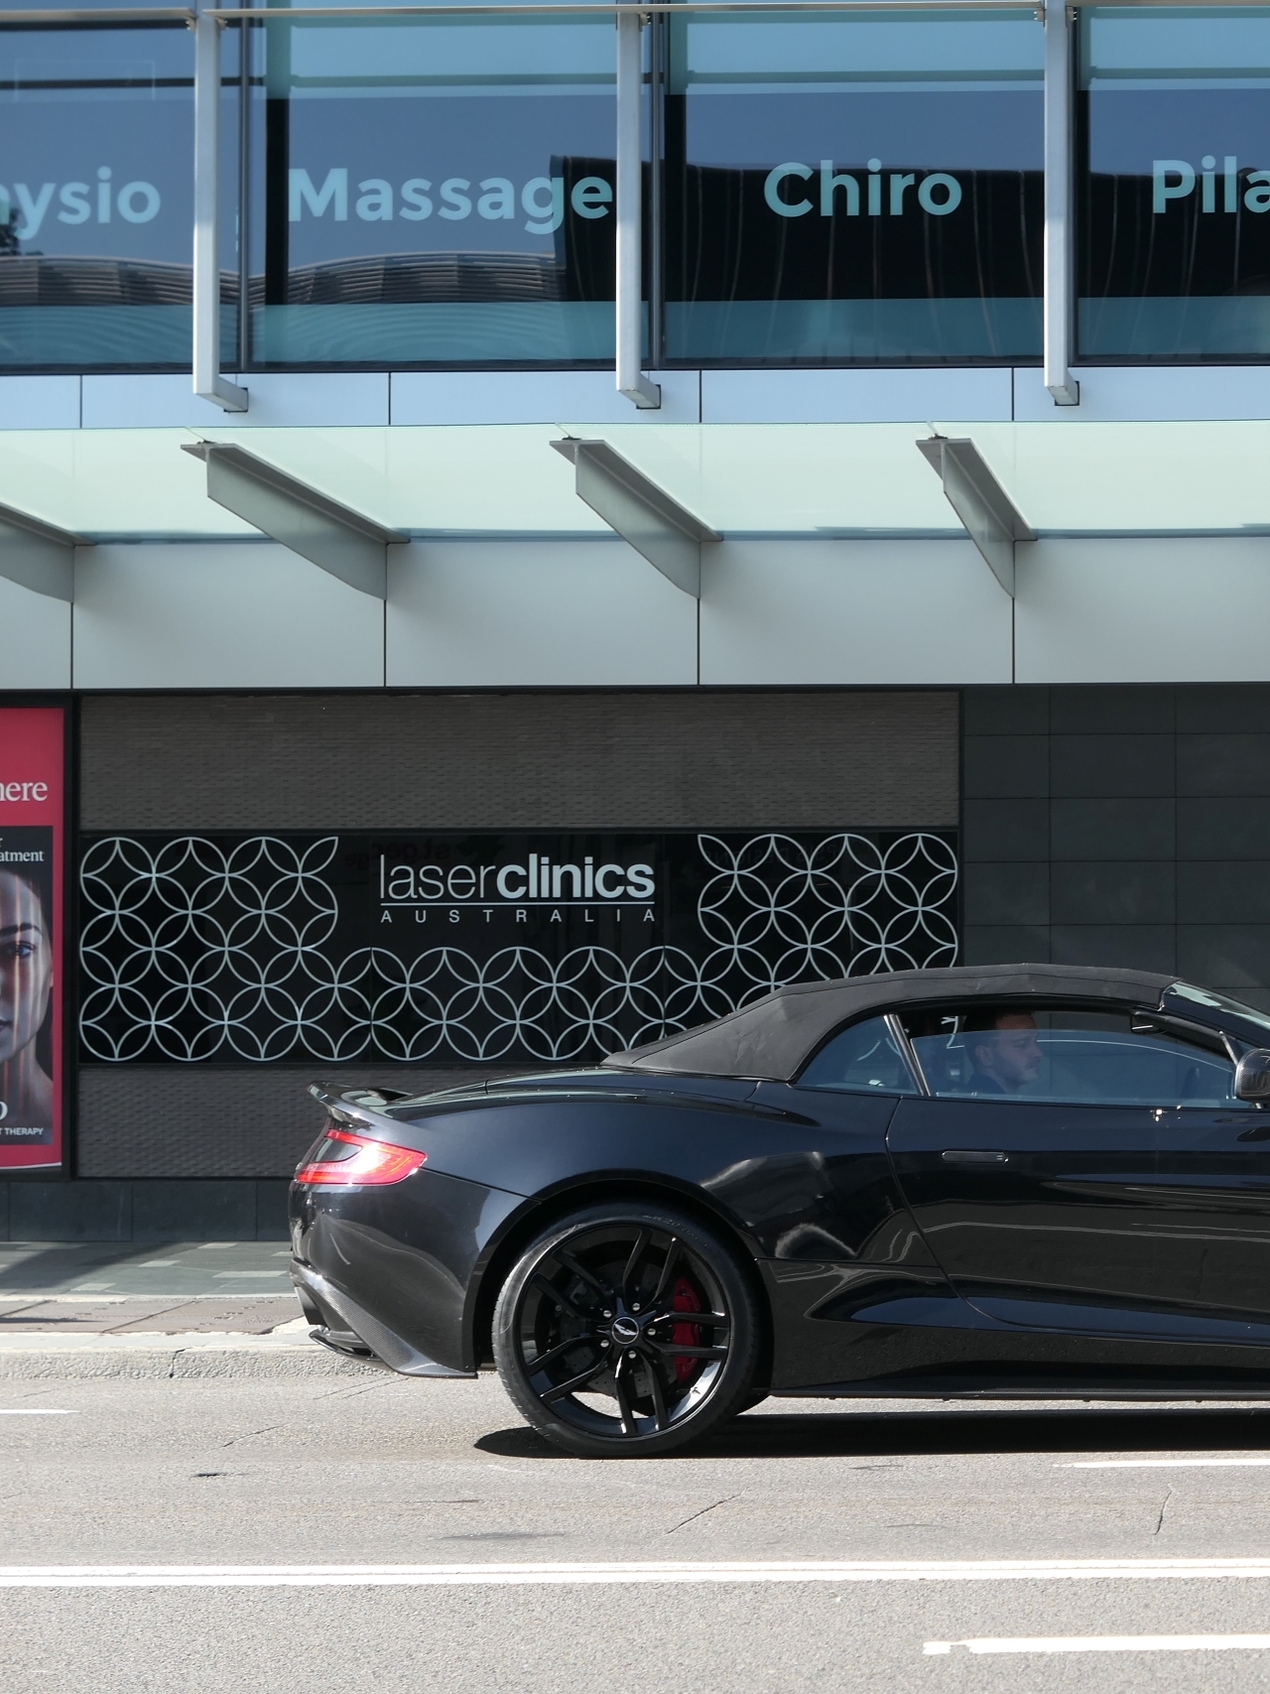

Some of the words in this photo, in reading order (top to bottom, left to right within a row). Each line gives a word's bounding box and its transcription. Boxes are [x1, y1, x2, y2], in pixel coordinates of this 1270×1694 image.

[289, 167, 613, 234] Massage
[764, 158, 963, 217] Chiro
[380, 853, 655, 900] laserclinics
[381, 909, 655, 924] AUSTRALIA
[4, 1127, 44, 1136] THERAPY
